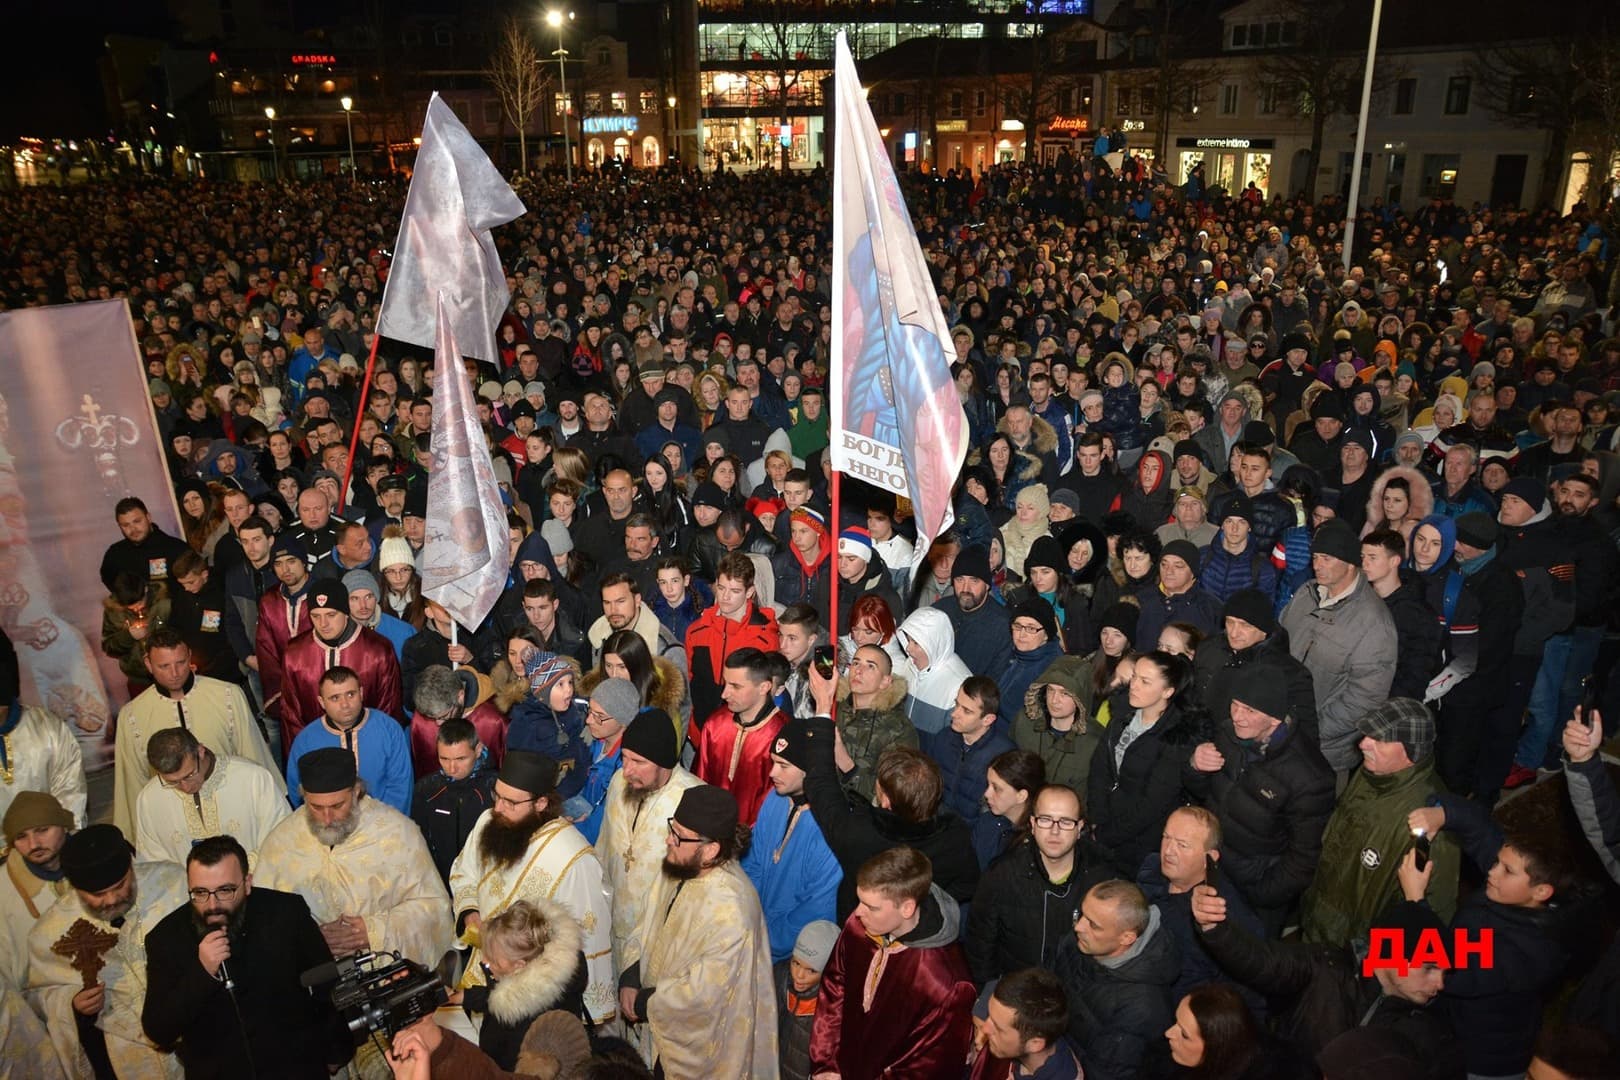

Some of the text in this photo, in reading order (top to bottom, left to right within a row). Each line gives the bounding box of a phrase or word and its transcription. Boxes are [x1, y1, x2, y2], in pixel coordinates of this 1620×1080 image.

[291, 55, 336, 64] GRADSKA
[1196, 138, 1225, 148] extreme
[842, 433, 885, 461] БОГ
[848, 457, 906, 490] НЕГО
